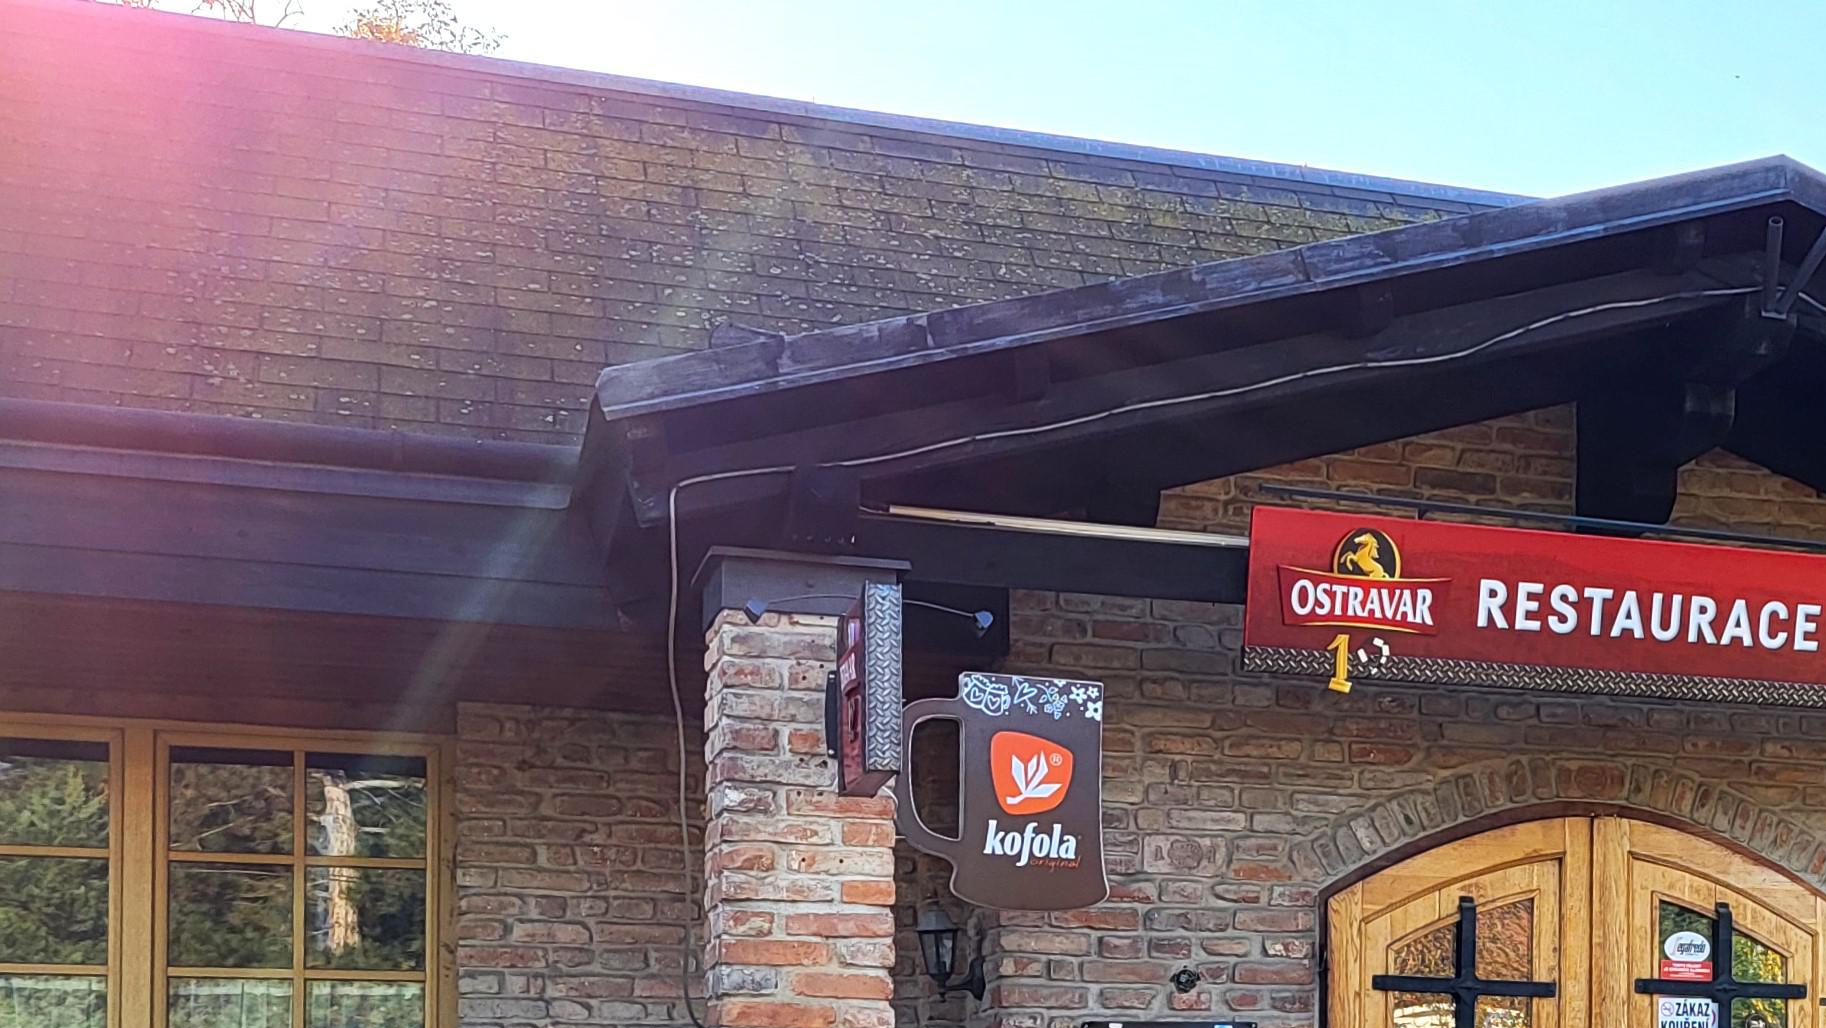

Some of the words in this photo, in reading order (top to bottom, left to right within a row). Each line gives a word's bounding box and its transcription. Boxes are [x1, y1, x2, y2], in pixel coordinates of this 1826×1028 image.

[1291, 579, 1434, 626] OSTRAVAR
[1476, 578, 1822, 652] RESTAURACE
[983, 820, 1077, 866] kofola
[1675, 999, 1710, 1017] ZÁKAZ
